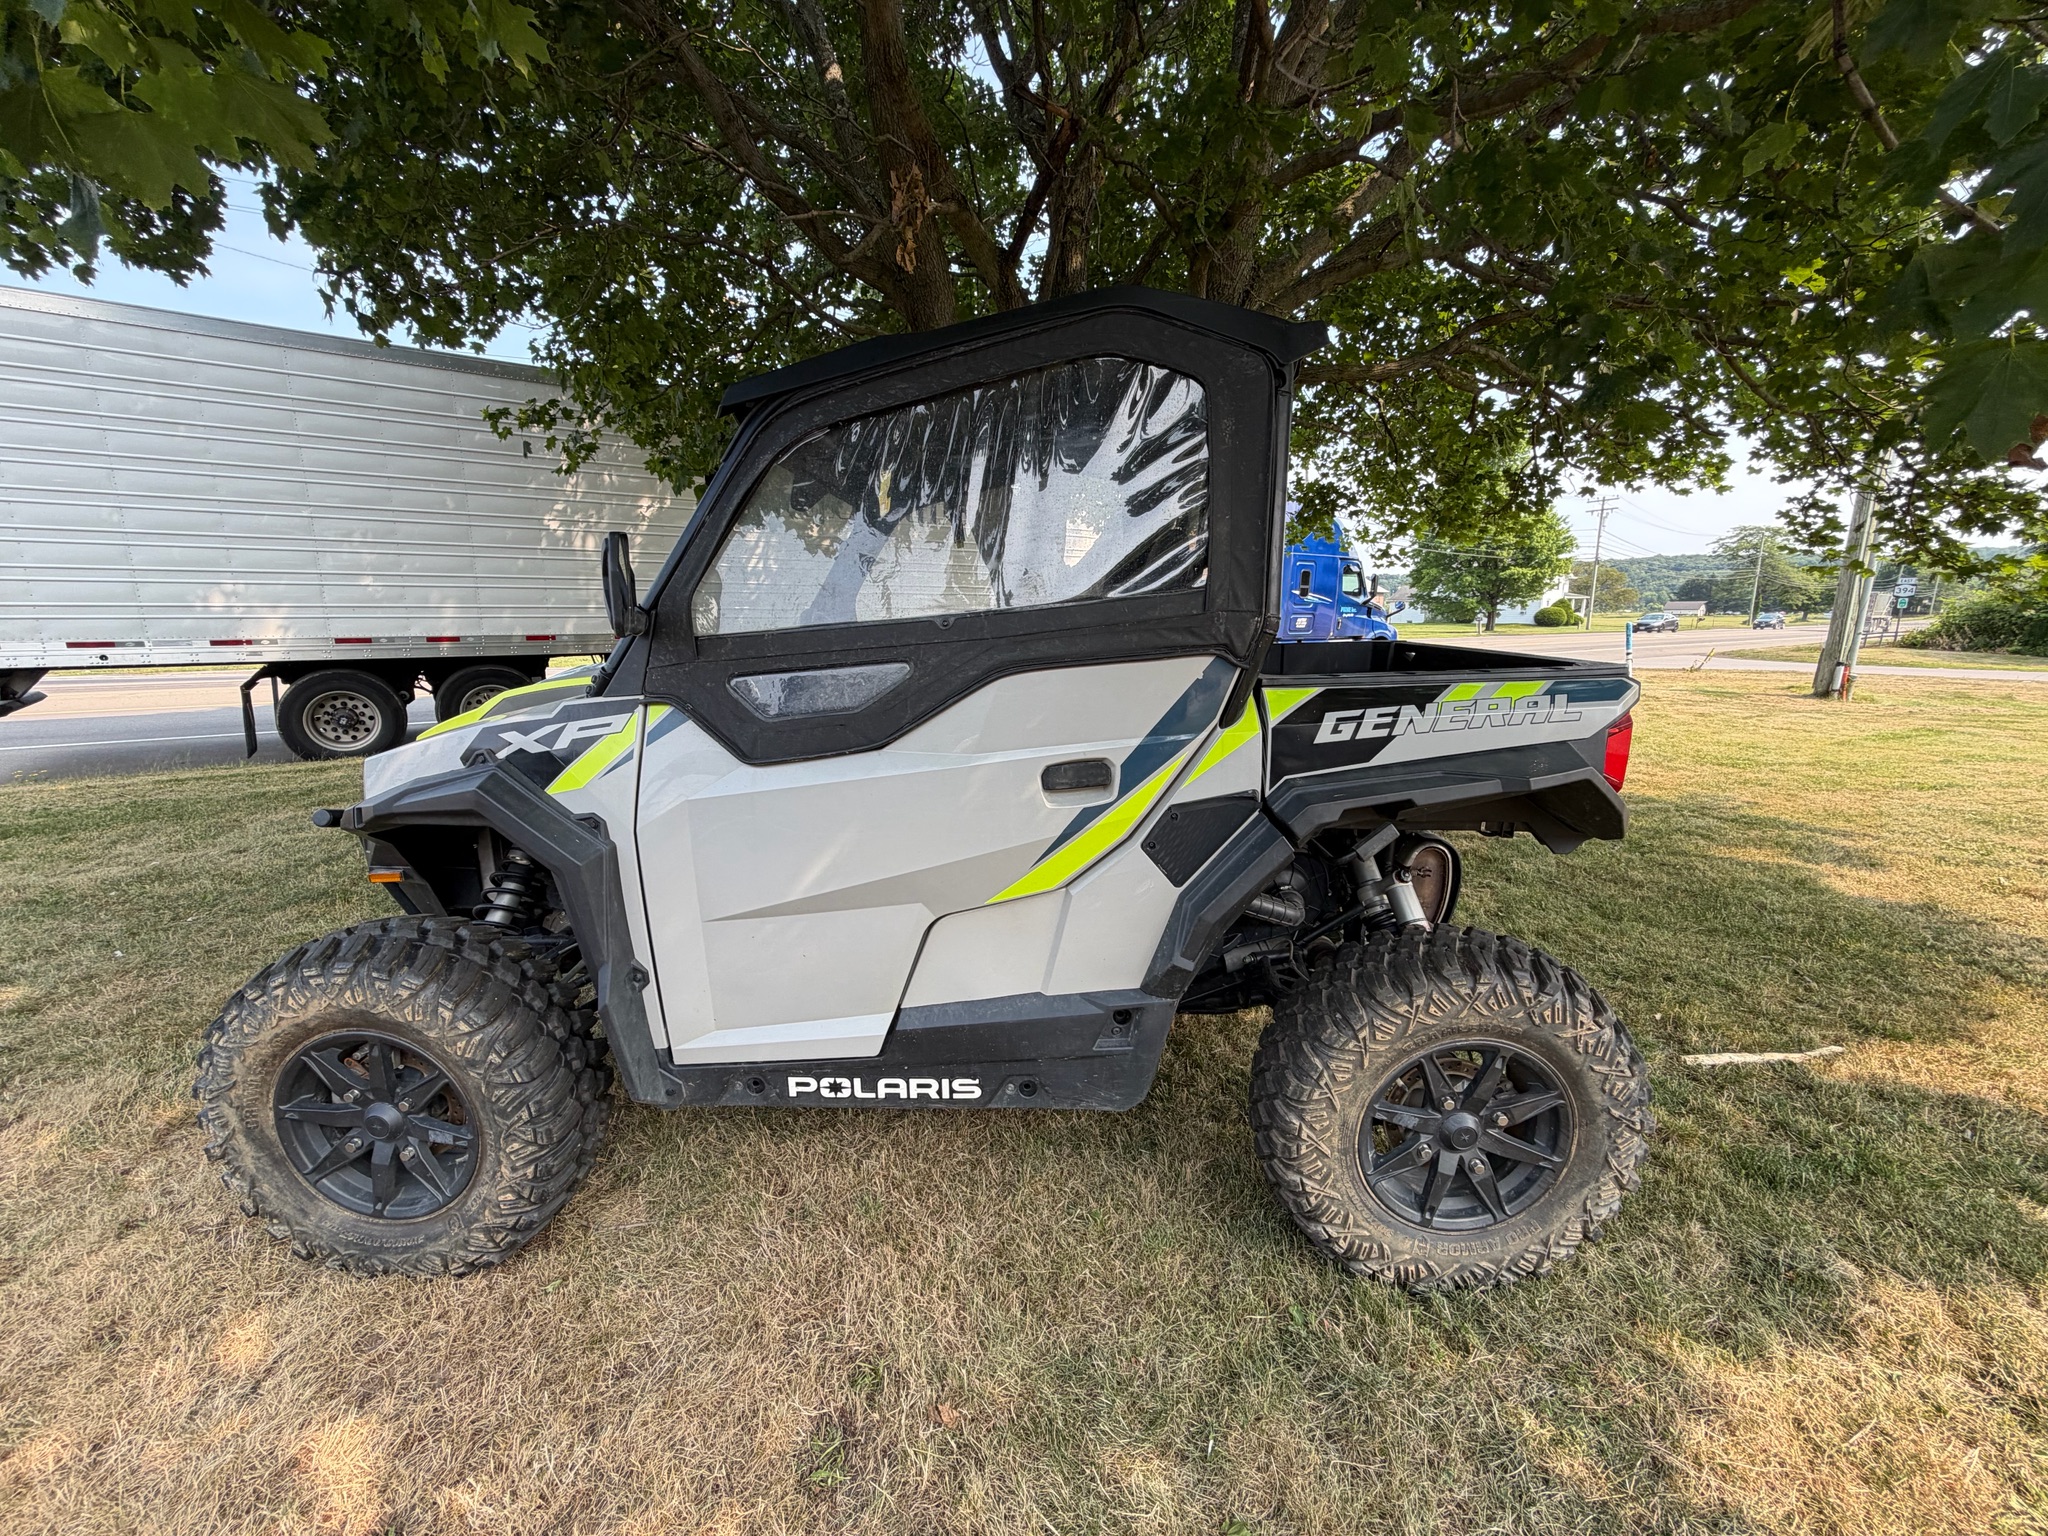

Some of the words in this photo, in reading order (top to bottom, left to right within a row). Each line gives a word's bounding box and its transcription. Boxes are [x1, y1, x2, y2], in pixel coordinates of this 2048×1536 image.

[1313, 694, 1582, 744] GENERAL
[495, 713, 633, 758] XP
[787, 1077, 982, 1099] POLARIS
[1504, 1220, 1543, 1246] PRO
[1436, 1237, 1501, 1257] ARMOR
